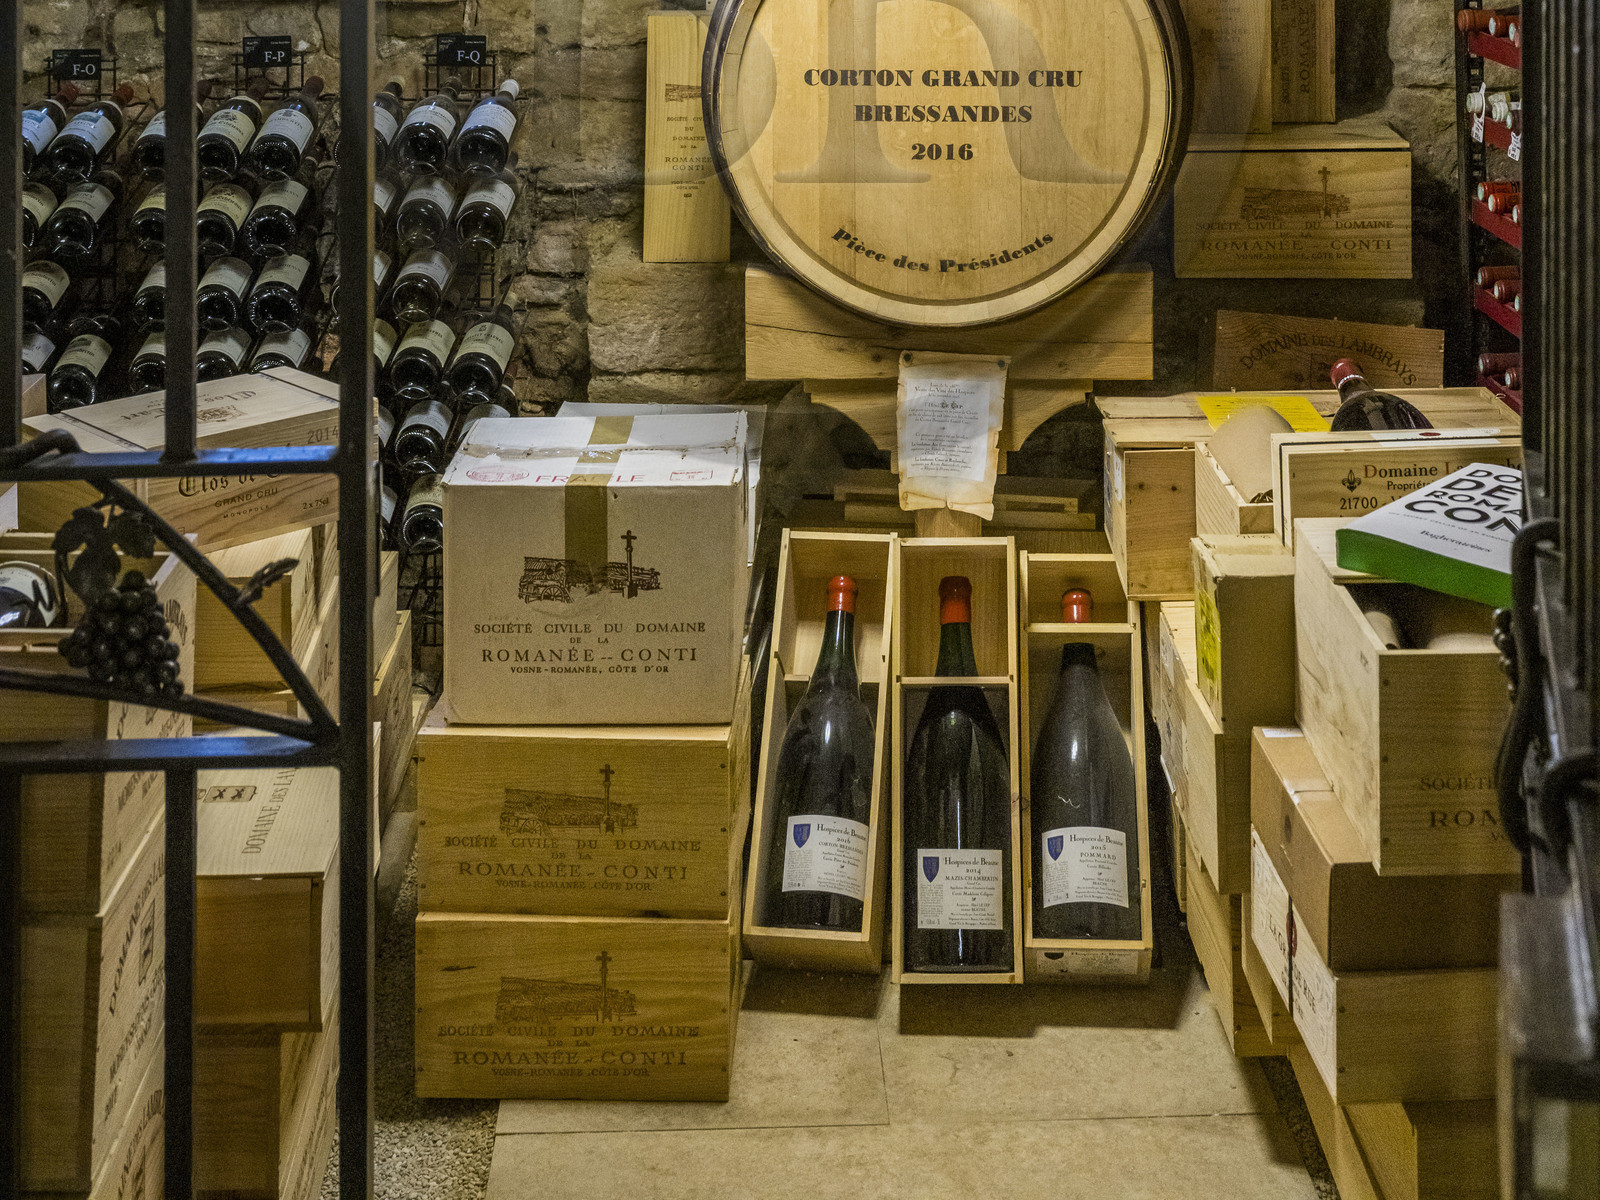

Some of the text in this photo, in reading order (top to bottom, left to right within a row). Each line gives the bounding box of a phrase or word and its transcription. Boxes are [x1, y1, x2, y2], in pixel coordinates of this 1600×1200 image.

[264, 51, 285, 63] F-P
[456, 50, 480, 64] F-Q
[72, 63, 96, 76] F-O
[804, 68, 1083, 88] CORTON GRAND CRU
[854, 104, 1032, 123] BRESSANDES
[911, 143, 974, 161] 2016
[1335, 220, 1394, 230] DOMAINE
[831, 227, 1055, 273] Pièce des Présidents
[1239, 332, 1418, 386] DOMAINE DES LAMBRAYS
[307, 425, 339, 445] 2014
[1364, 464, 1438, 479] Domaine
[214, 487, 279, 508] GRAND CRU
[1340, 496, 1378, 510] 21700
[222, 504, 271, 519] MONOPOLE
[474, 621, 706, 634] SOCIÉTÉ CIVILE DU DOMAINE
[608, 663, 637, 674] CÔTE
[241, 805, 281, 854] DOMAINE
[445, 834, 701, 852] SOCIÉTÉ CIVILE DU DOMAINE
[551, 852, 592, 860] DE LA
[1080, 852, 1117, 860] POMMARD
[438, 1023, 700, 1038] SOCIÉTÉ CIVILE DU DOMAINE
